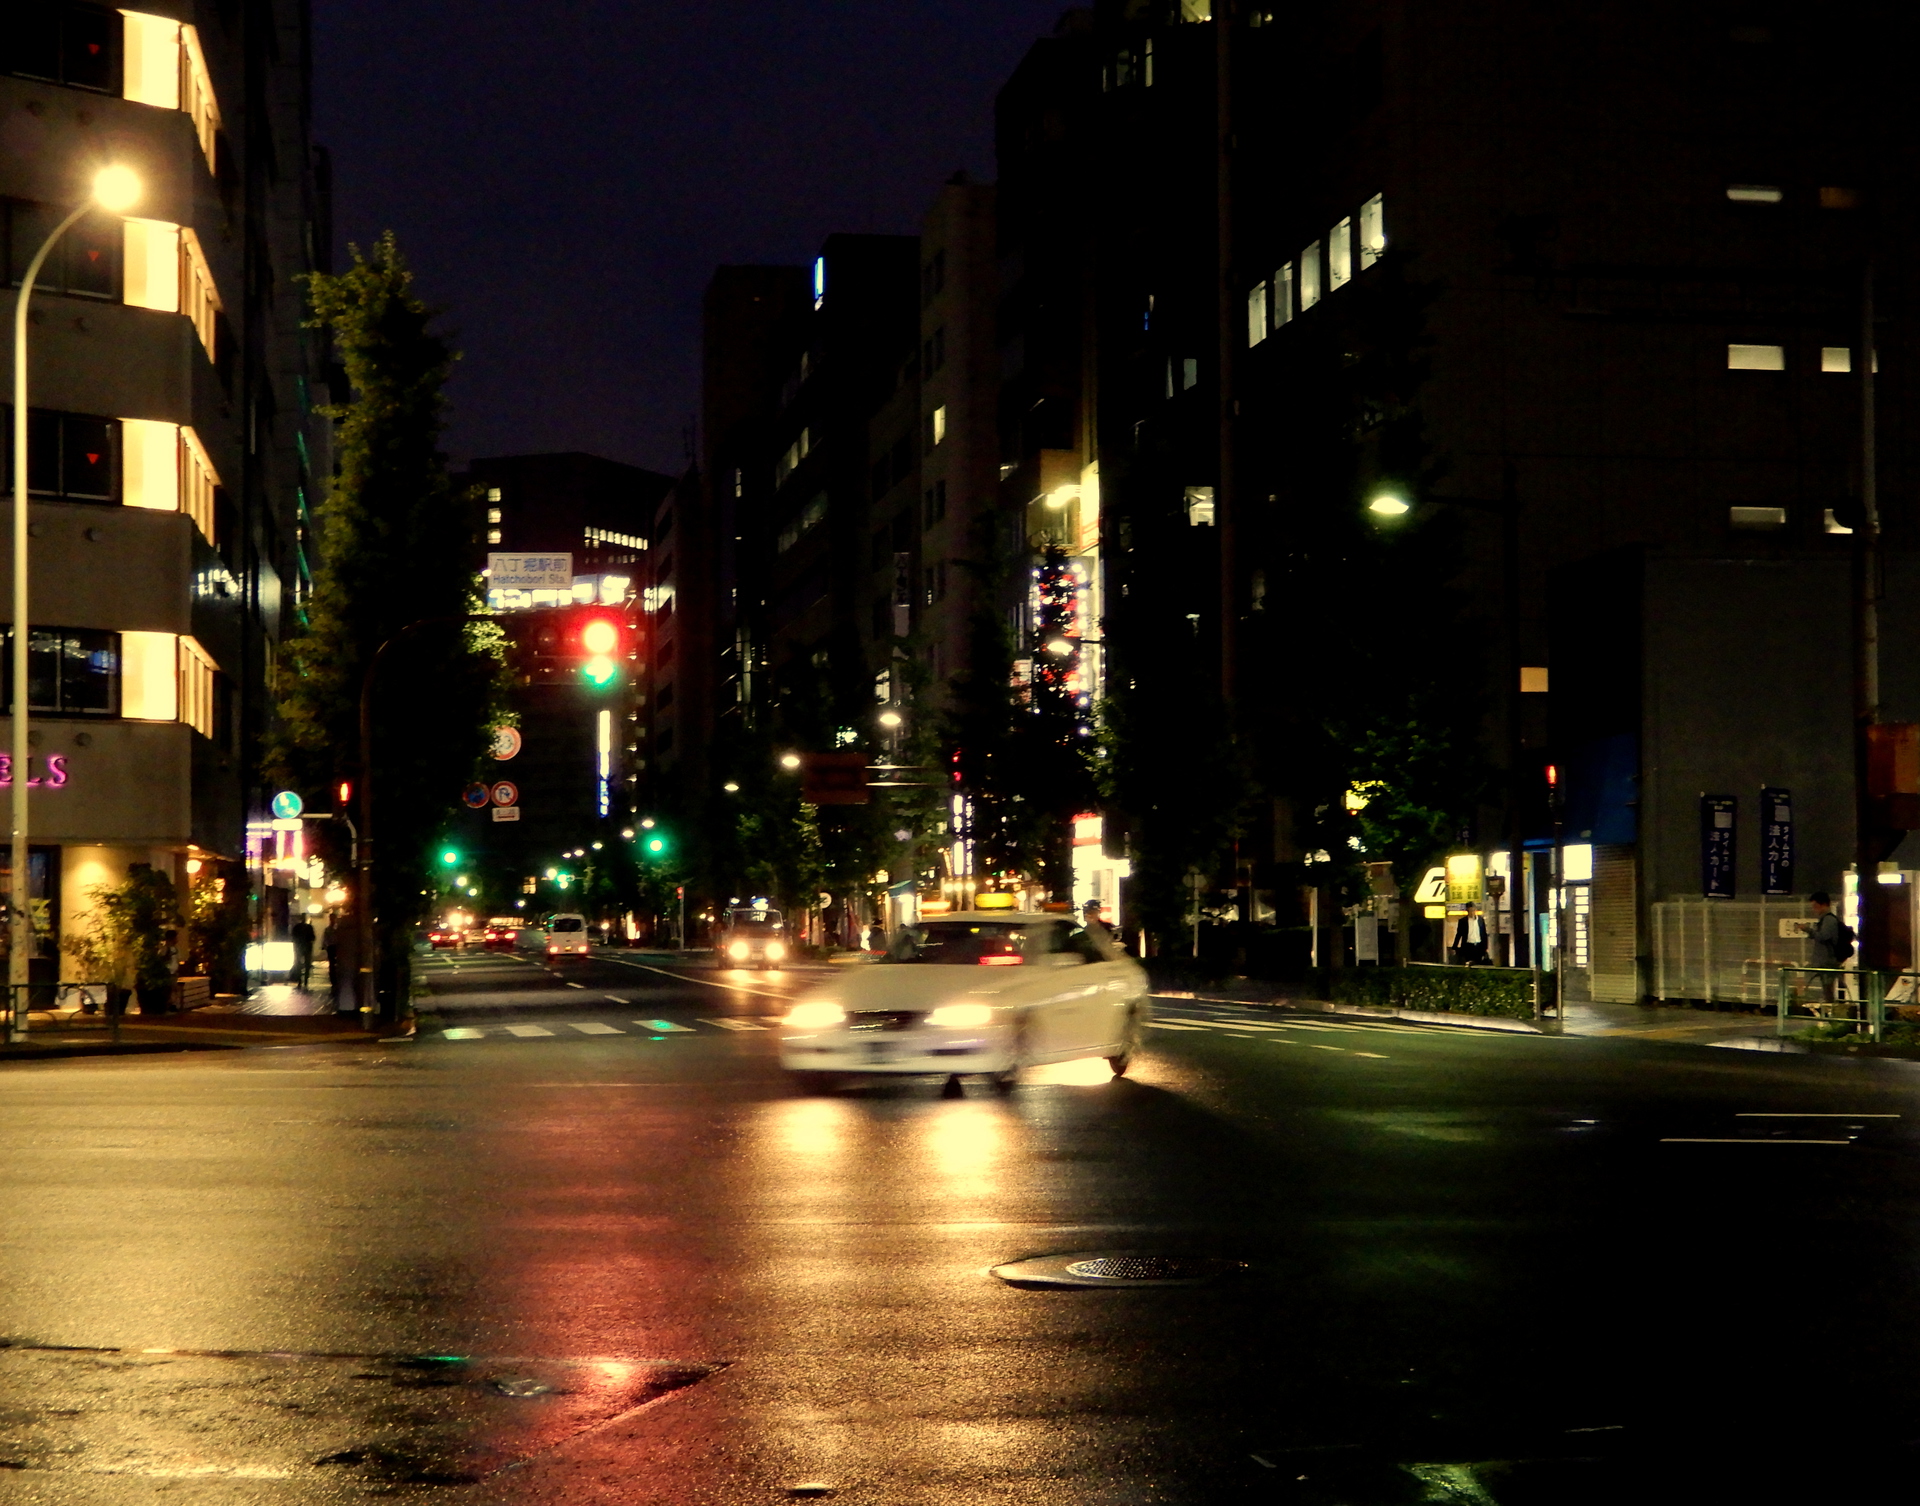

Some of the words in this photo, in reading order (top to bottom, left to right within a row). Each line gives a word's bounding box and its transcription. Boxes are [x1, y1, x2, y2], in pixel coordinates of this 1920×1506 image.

[493, 557, 567, 572] 八丁堀駅前
